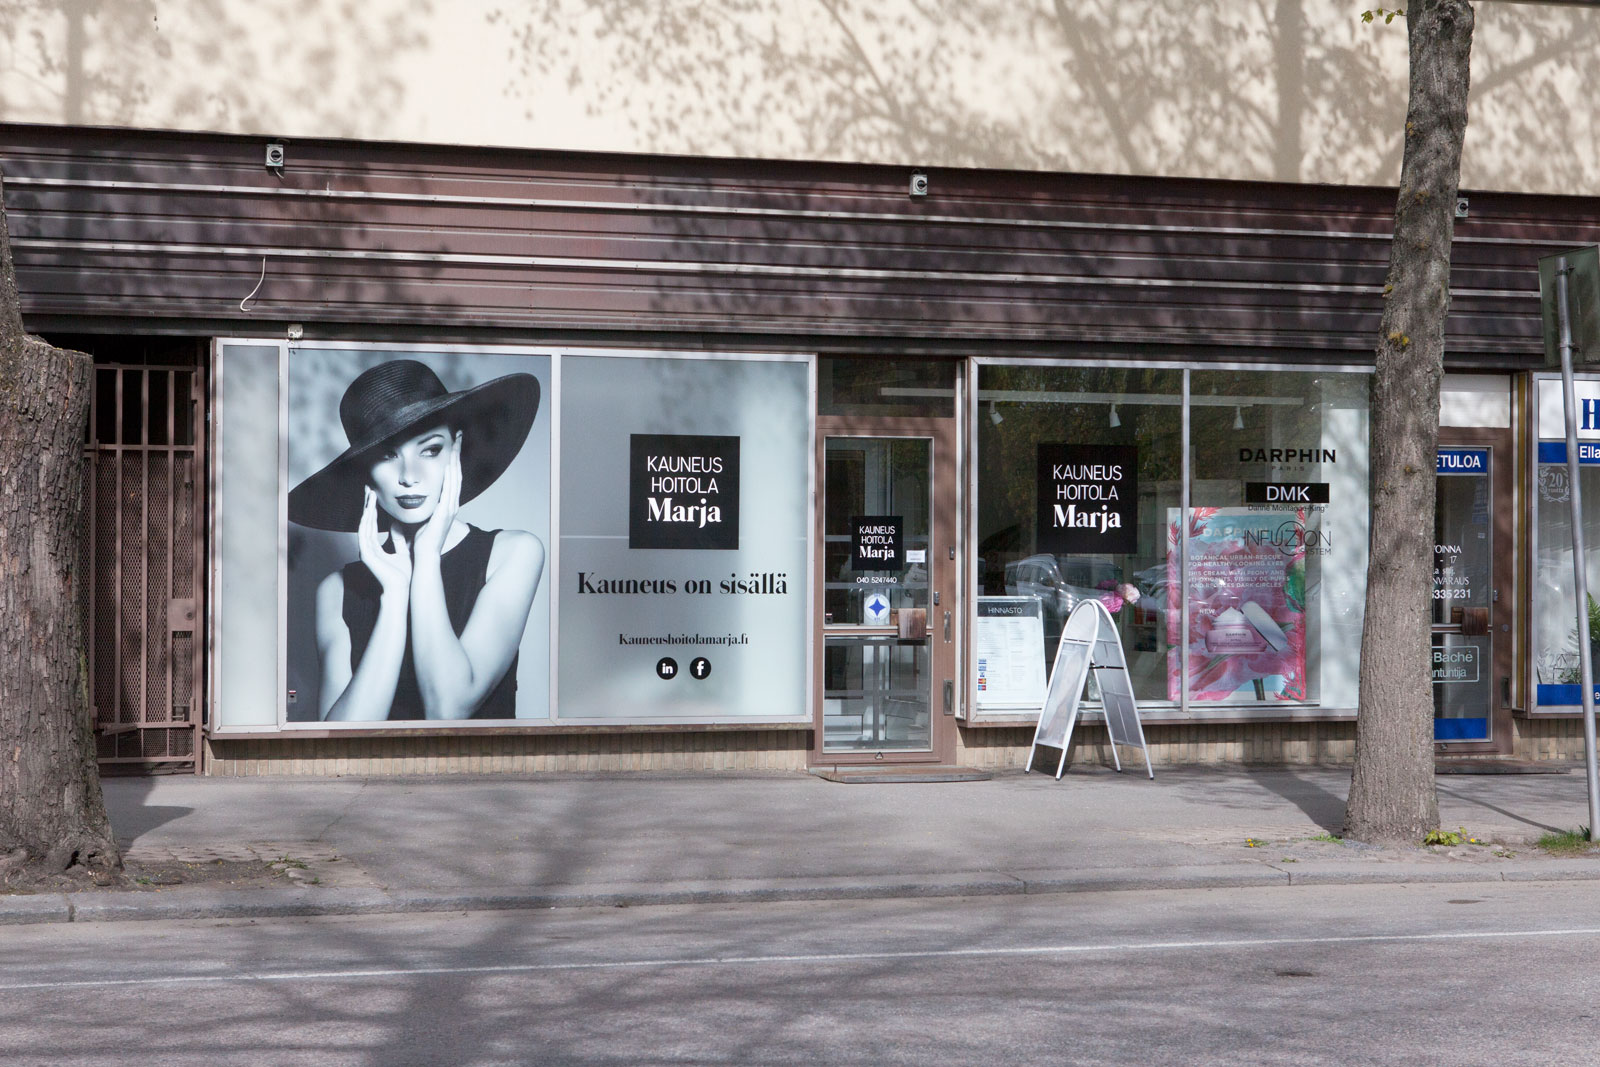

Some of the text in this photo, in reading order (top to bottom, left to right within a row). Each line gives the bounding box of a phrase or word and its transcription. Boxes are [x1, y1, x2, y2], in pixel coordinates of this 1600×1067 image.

[1239, 448, 1336, 463] DARPHIN
[647, 455, 723, 473] KAUNEUS
[1053, 464, 1122, 481] KAUNEUS
[1548, 473, 1563, 487] 20
[651, 477, 719, 494] HOITOLA
[1057, 484, 1119, 501] HOITOLA
[1266, 485, 1310, 501] DMK
[647, 497, 722, 528] Marja
[1053, 504, 1122, 534] Marja
[859, 525, 896, 535] KAUNEUS
[861, 535, 894, 545] HOITOLA
[859, 545, 895, 561] Marja
[1433, 544, 1463, 554] OINNA
[577, 571, 788, 594] Kauneus on sisällä
[1453, 588, 1471, 599] 231
[618, 633, 749, 646] Kauneushoitolamarja.fi
